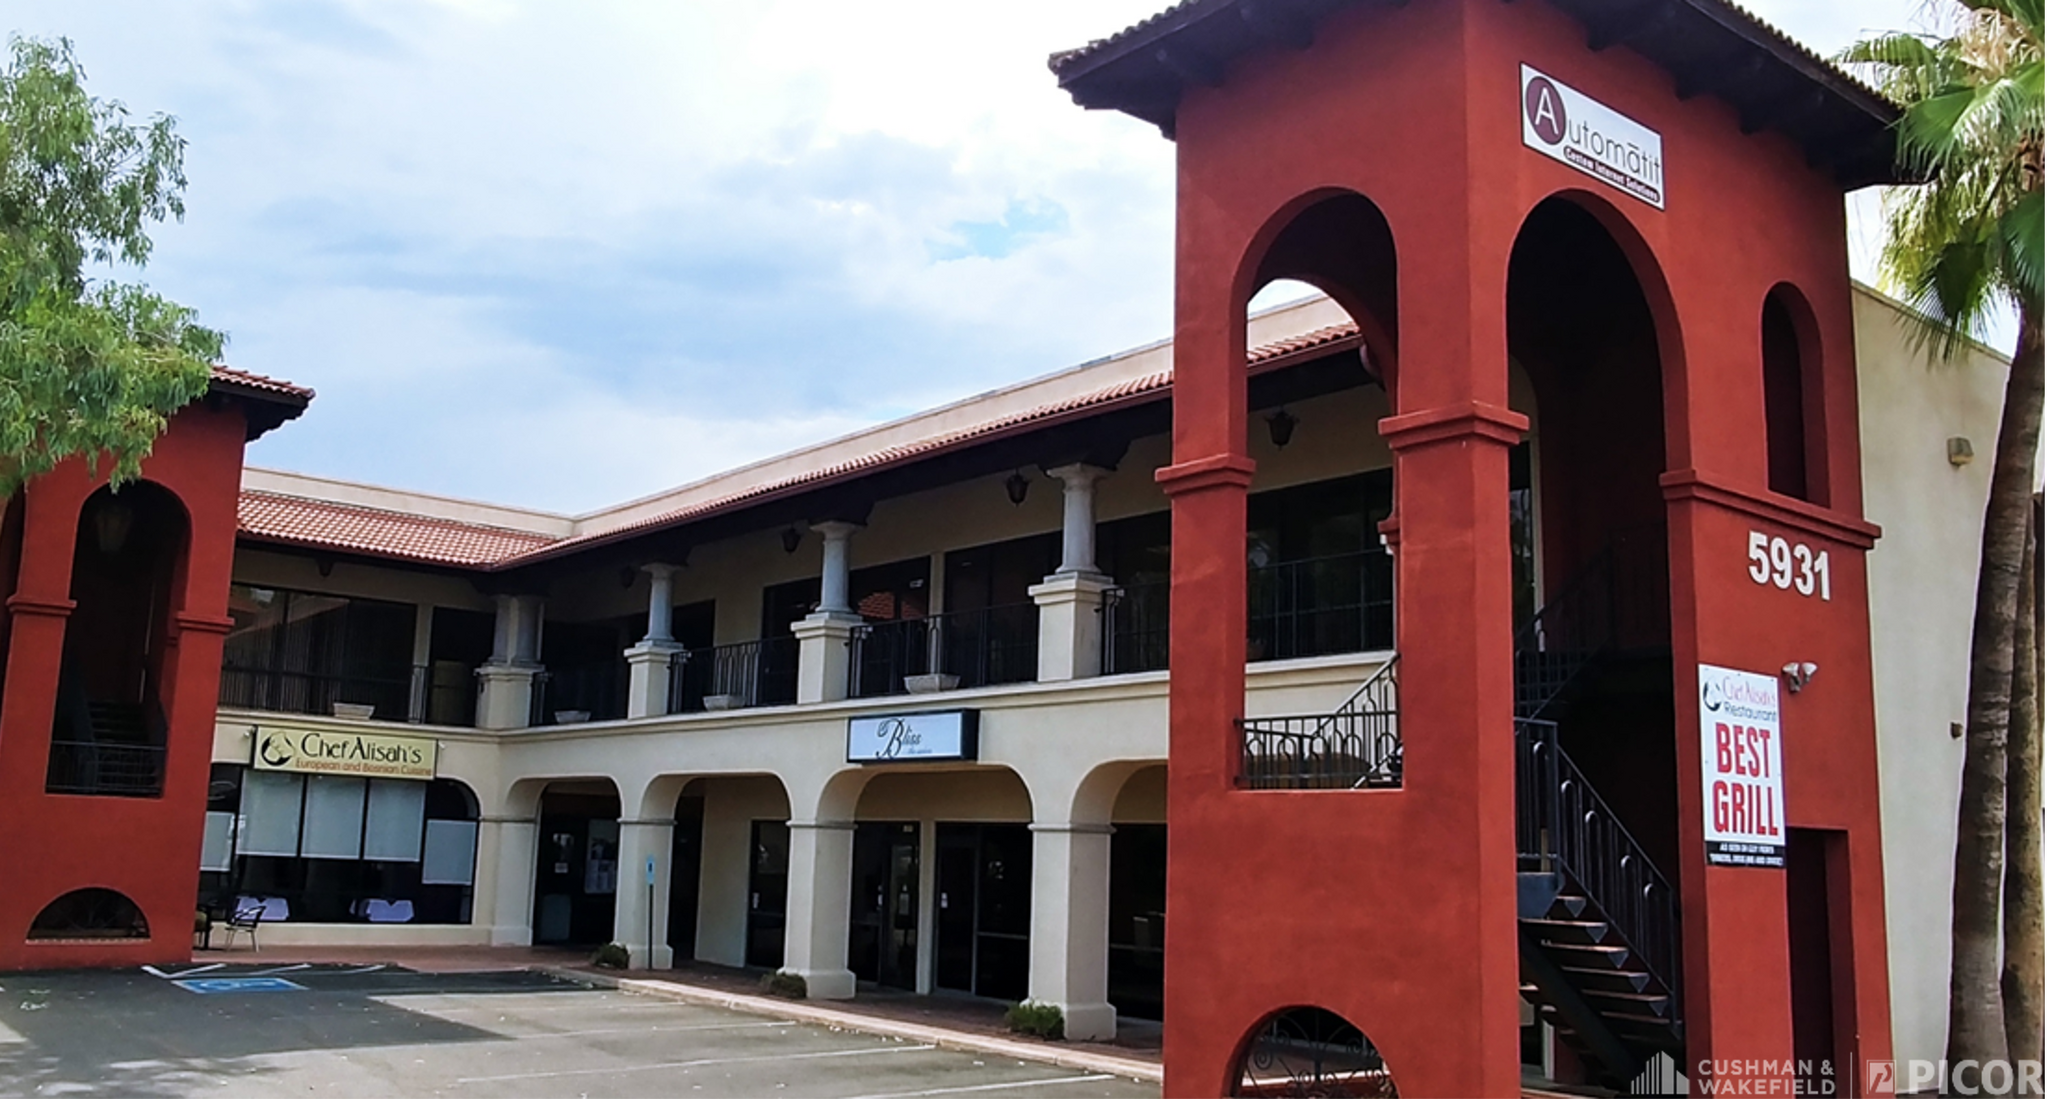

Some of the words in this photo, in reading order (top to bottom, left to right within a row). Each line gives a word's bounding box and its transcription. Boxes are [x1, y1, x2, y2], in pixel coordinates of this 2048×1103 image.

[1748, 529, 1831, 601] 5931
[1723, 701, 1777, 722] Restaurant
[300, 732, 349, 759] Chef
[350, 736, 422, 765] Alisah's
[875, 717, 922, 759] Bliss
[1715, 721, 1771, 778] BEST
[295, 758, 340, 772] European
[342, 761, 361, 772] and
[362, 762, 399, 774] Bosnian
[400, 765, 432, 776] Cuisine
[1712, 780, 1779, 836] GRILL
